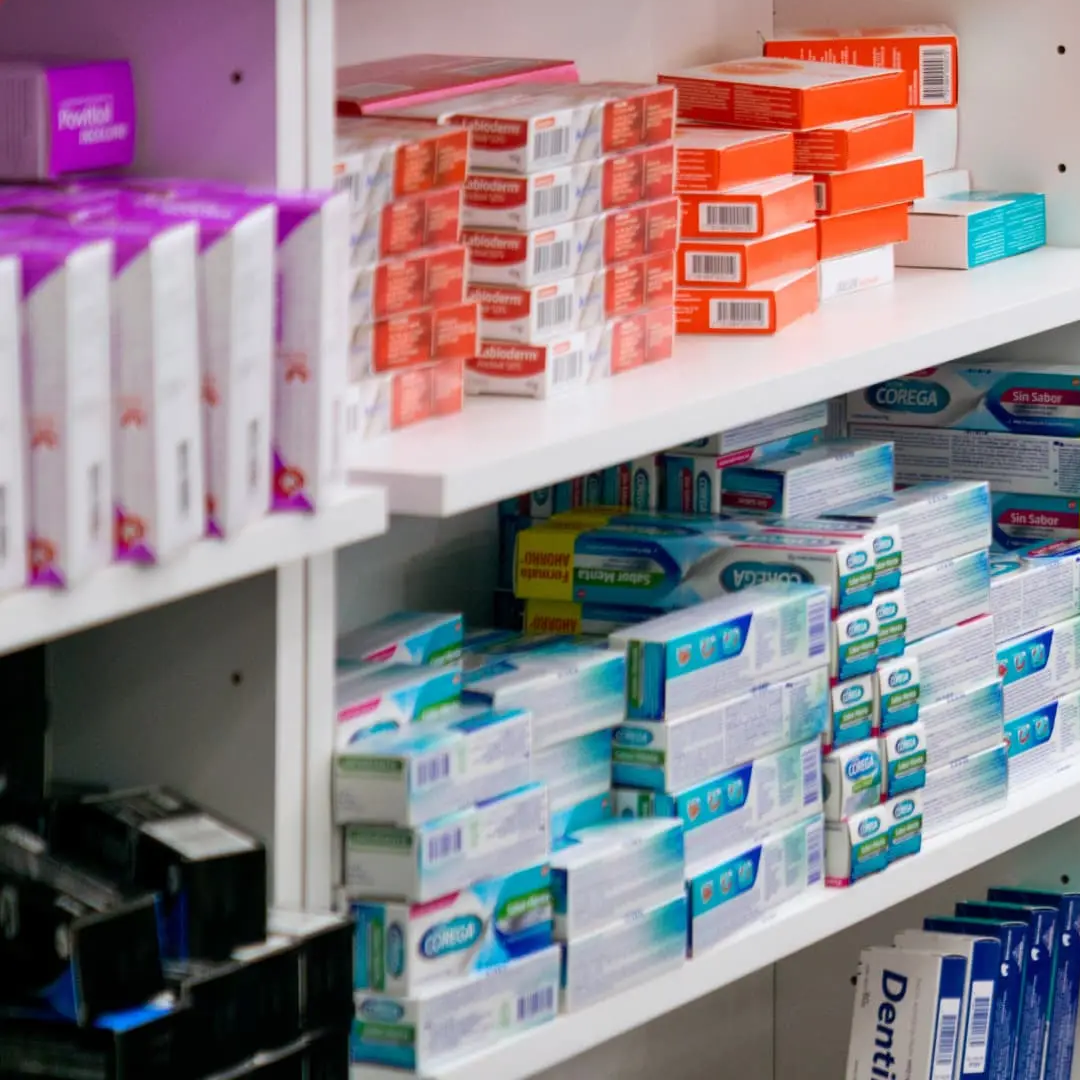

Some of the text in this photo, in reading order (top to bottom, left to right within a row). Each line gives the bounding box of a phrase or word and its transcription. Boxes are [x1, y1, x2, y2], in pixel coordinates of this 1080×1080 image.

[467, 289, 522, 306] abioderm
[875, 387, 938, 407] COREGA
[1012, 390, 1062, 404] Sin Sabor
[1010, 512, 1059, 526] Sin Sabor
[520, 568, 571, 583] Formato
[577, 568, 652, 586] Sabor Menta
[870, 968, 908, 1080] Denti
